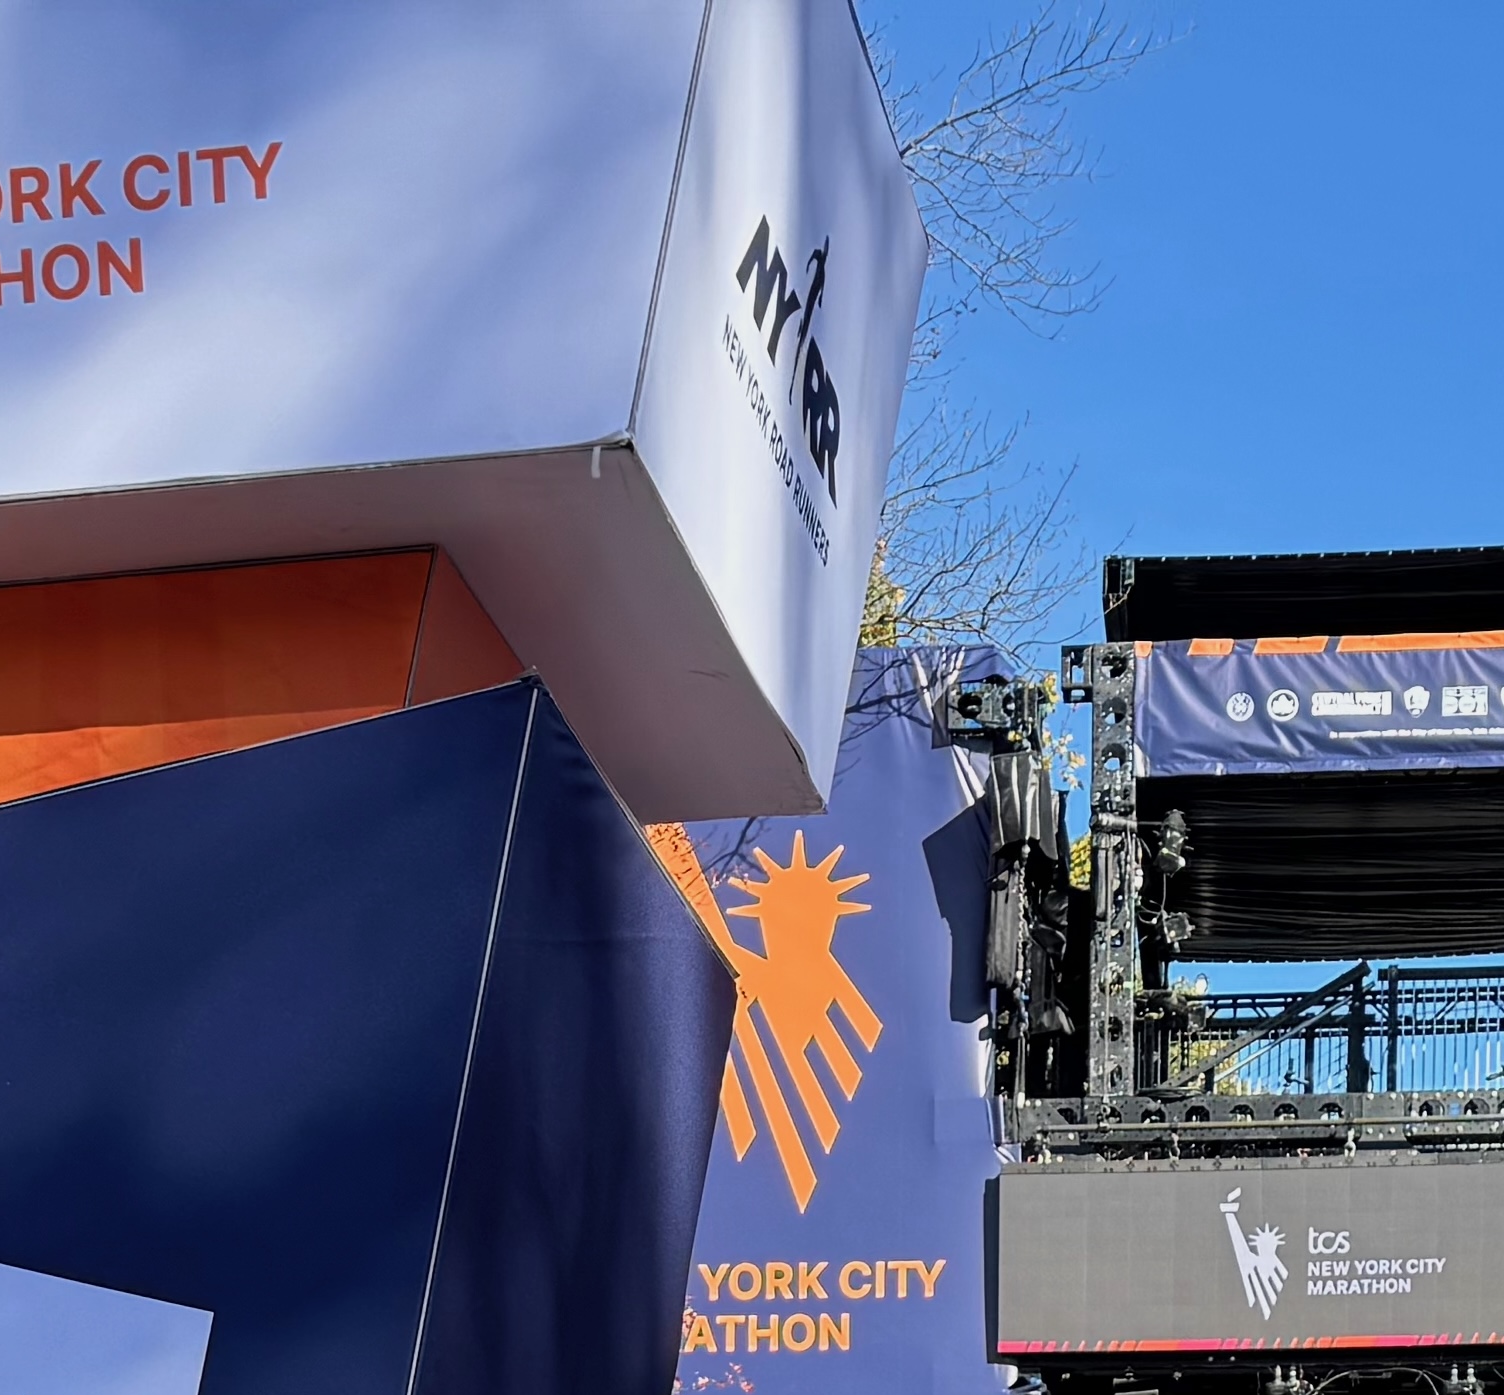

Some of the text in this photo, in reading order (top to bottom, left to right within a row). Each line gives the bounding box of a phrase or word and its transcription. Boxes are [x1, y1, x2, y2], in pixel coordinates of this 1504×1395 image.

[122, 141, 283, 213] CITY
[722, 313, 830, 567] NEW YORK ROAD RUNNERS
[1308, 1226, 1351, 1255] tcs
[697, 1259, 948, 1302] YORK CITY
[1307, 1257, 1447, 1277] NEW YORK CITY
[1307, 1277, 1413, 1296] MARATHON
